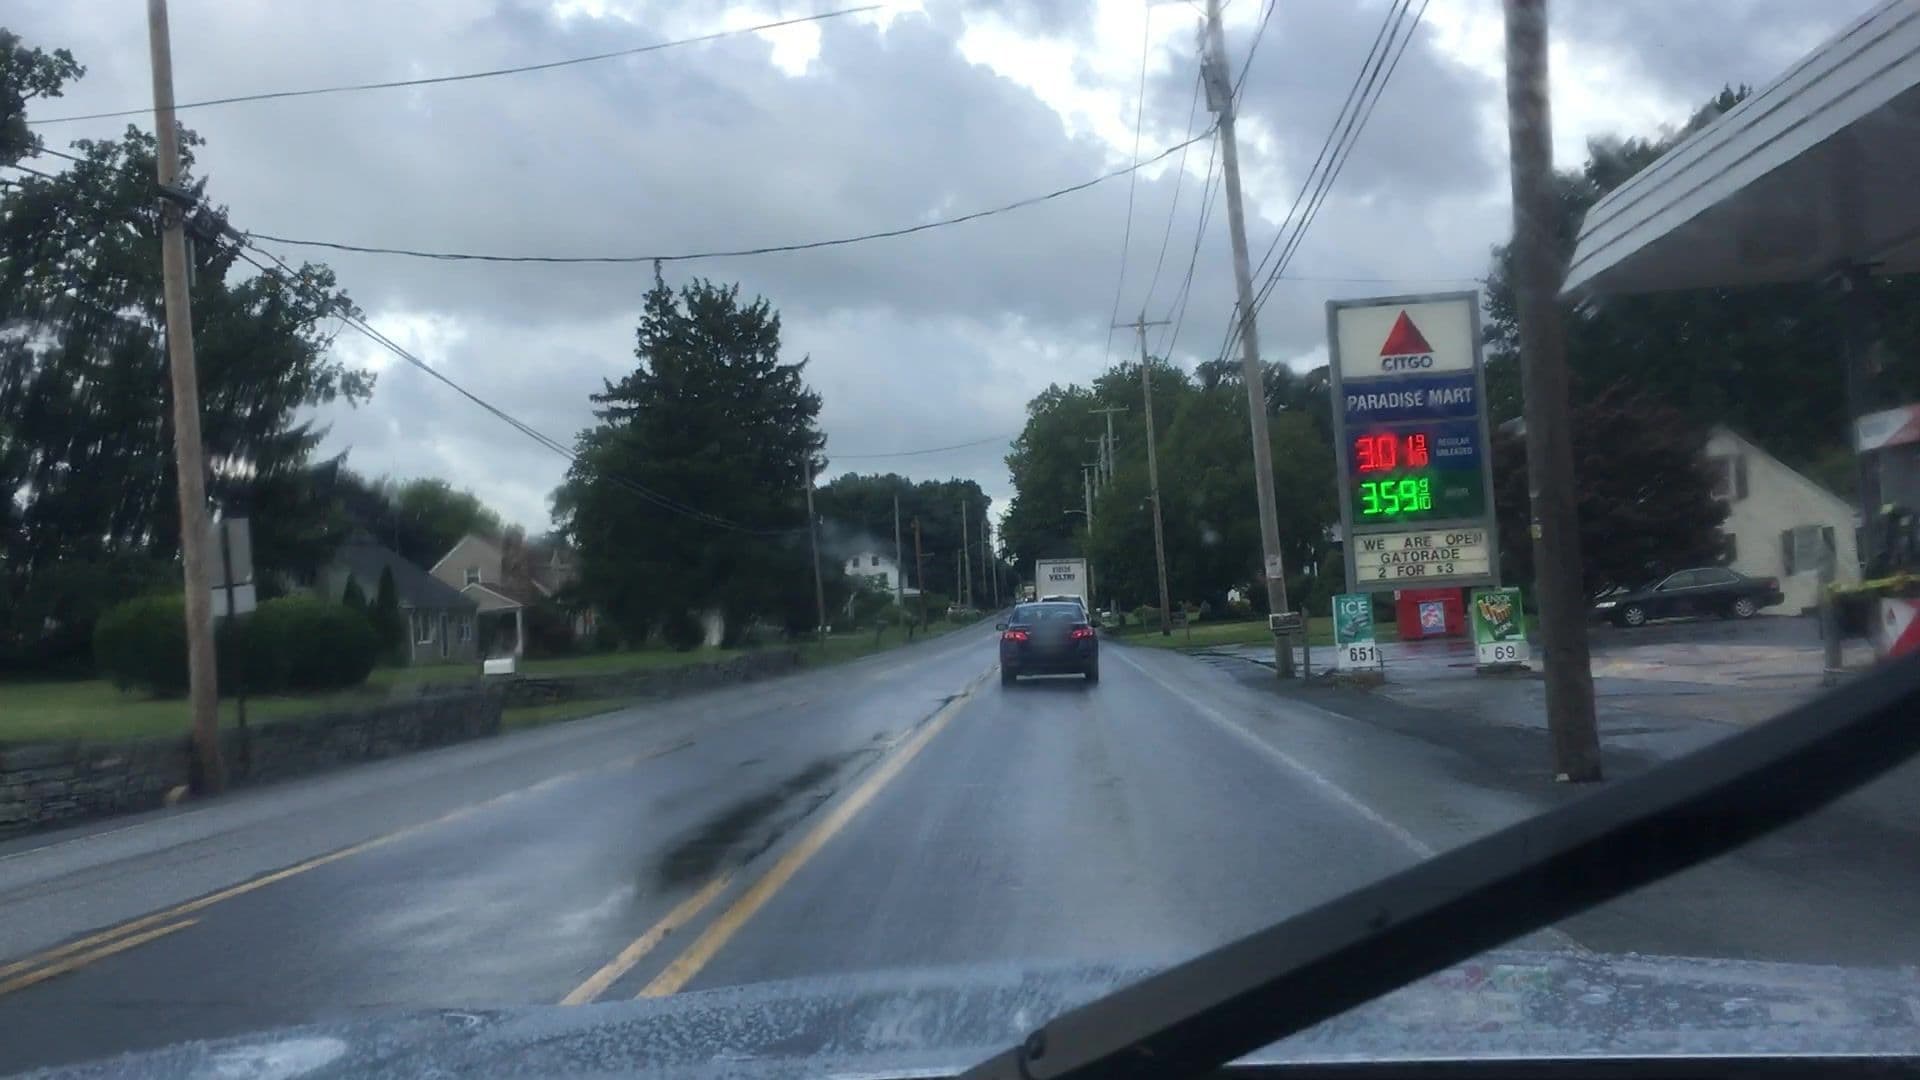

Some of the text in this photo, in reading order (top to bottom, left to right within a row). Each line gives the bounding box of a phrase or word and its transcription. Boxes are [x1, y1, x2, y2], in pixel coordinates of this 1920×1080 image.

[1381, 355, 1433, 371] CITGO
[1347, 387, 1473, 412] PARADISE MART
[1363, 533, 1482, 551] WE ARE OPEN
[1381, 548, 1460, 565] GATORADE
[1378, 567, 1386, 578] 2
[1397, 564, 1425, 577] FOR
[1340, 600, 1369, 615] ICE
[1349, 646, 1375, 662] 651
[1494, 645, 1516, 660] 69
